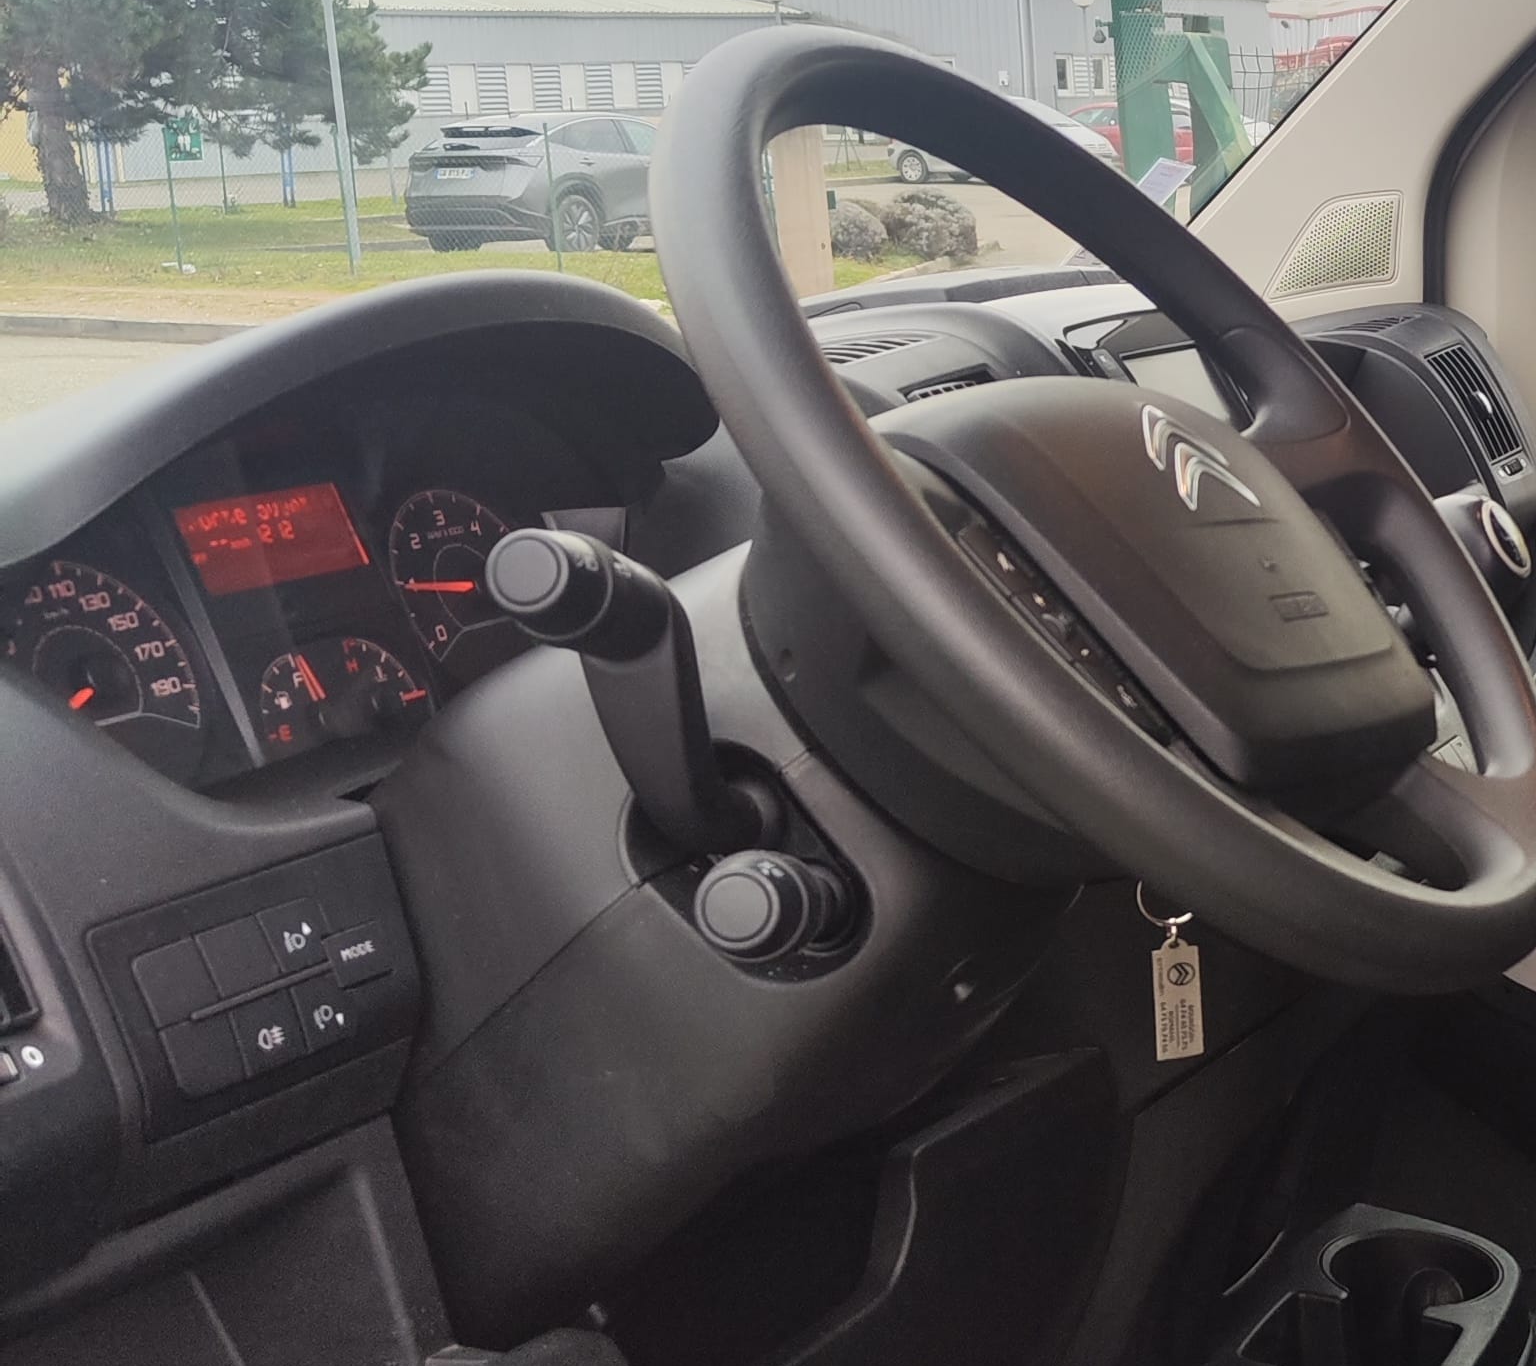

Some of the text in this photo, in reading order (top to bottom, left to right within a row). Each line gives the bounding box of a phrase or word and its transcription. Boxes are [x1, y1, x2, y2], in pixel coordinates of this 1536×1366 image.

[433, 509, 446, 526] 3
[470, 520, 482, 536] 4
[409, 533, 422, 549] 2
[48, 579, 77, 599] 110
[78, 591, 111, 611] 130
[107, 611, 139, 631] 150
[134, 640, 165, 662] 170
[150, 676, 182, 697] 190
[340, 939, 376, 962] MODE
